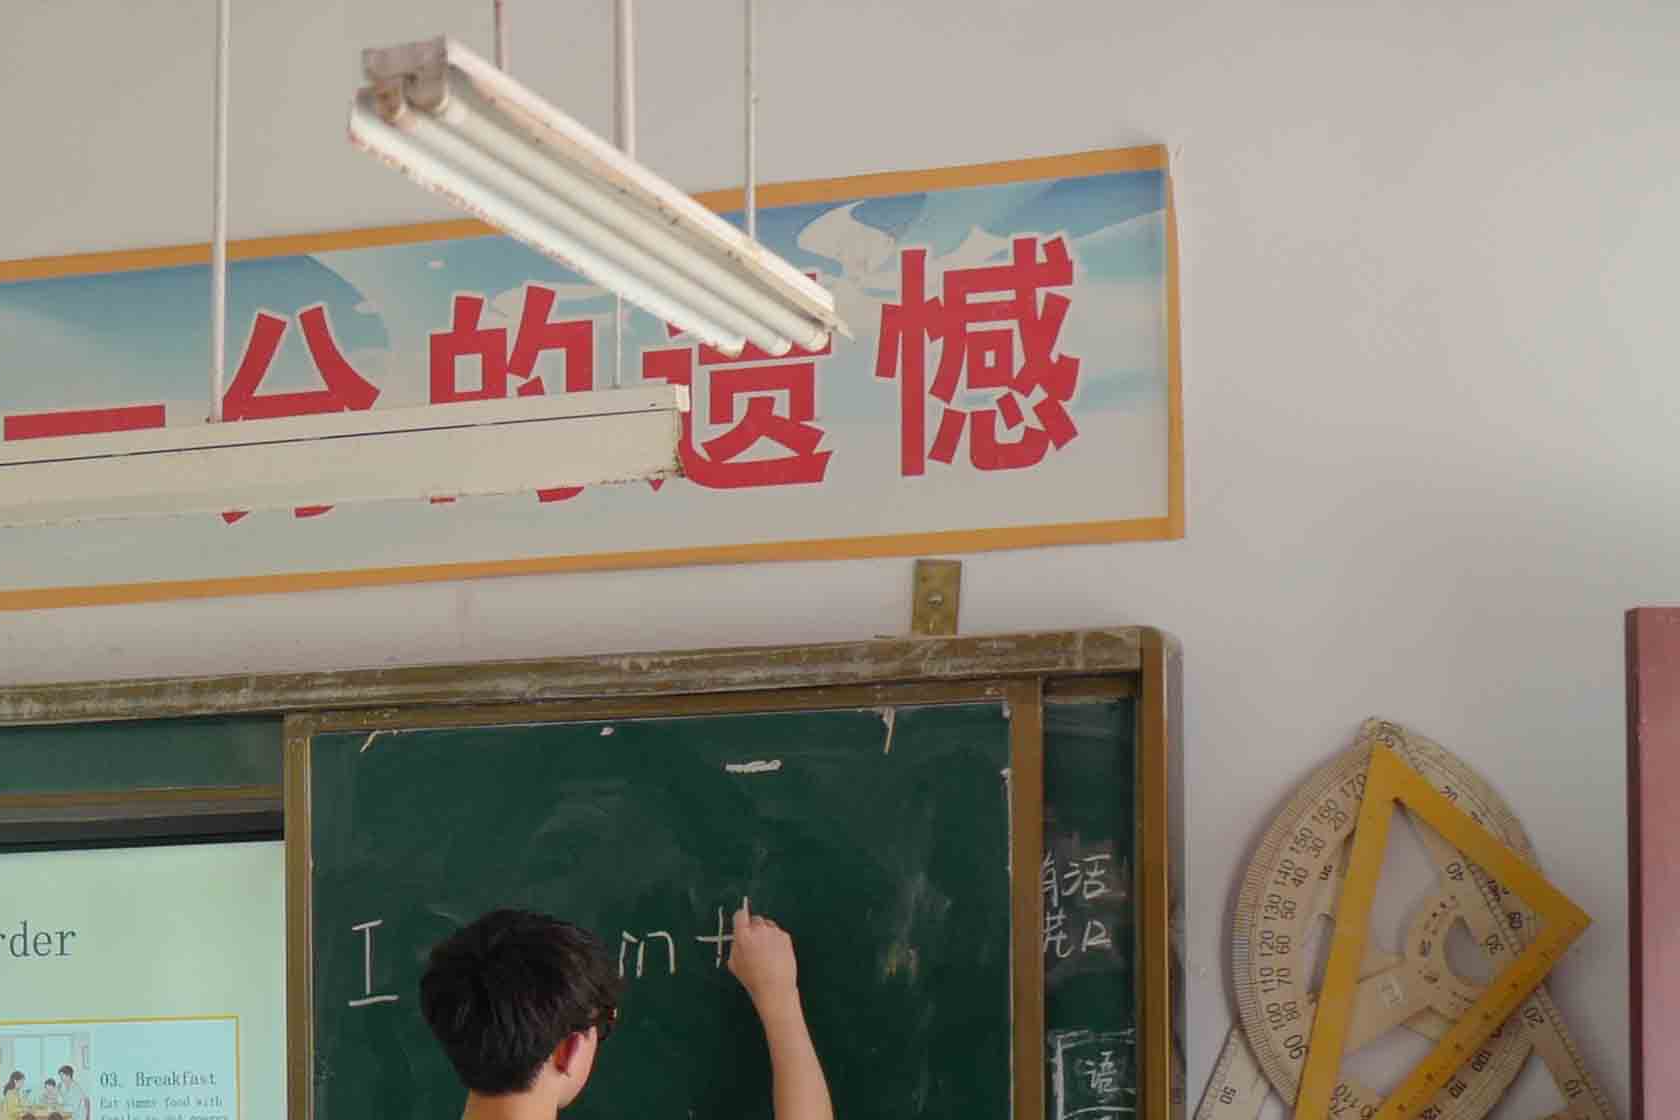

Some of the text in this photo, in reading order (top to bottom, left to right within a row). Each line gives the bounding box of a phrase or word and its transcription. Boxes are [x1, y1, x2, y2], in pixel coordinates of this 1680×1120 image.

[1259, 929, 1274, 957] 120
[1275, 935, 1291, 955] 60
[100, 1071, 216, 1088] 03. Breakfast
